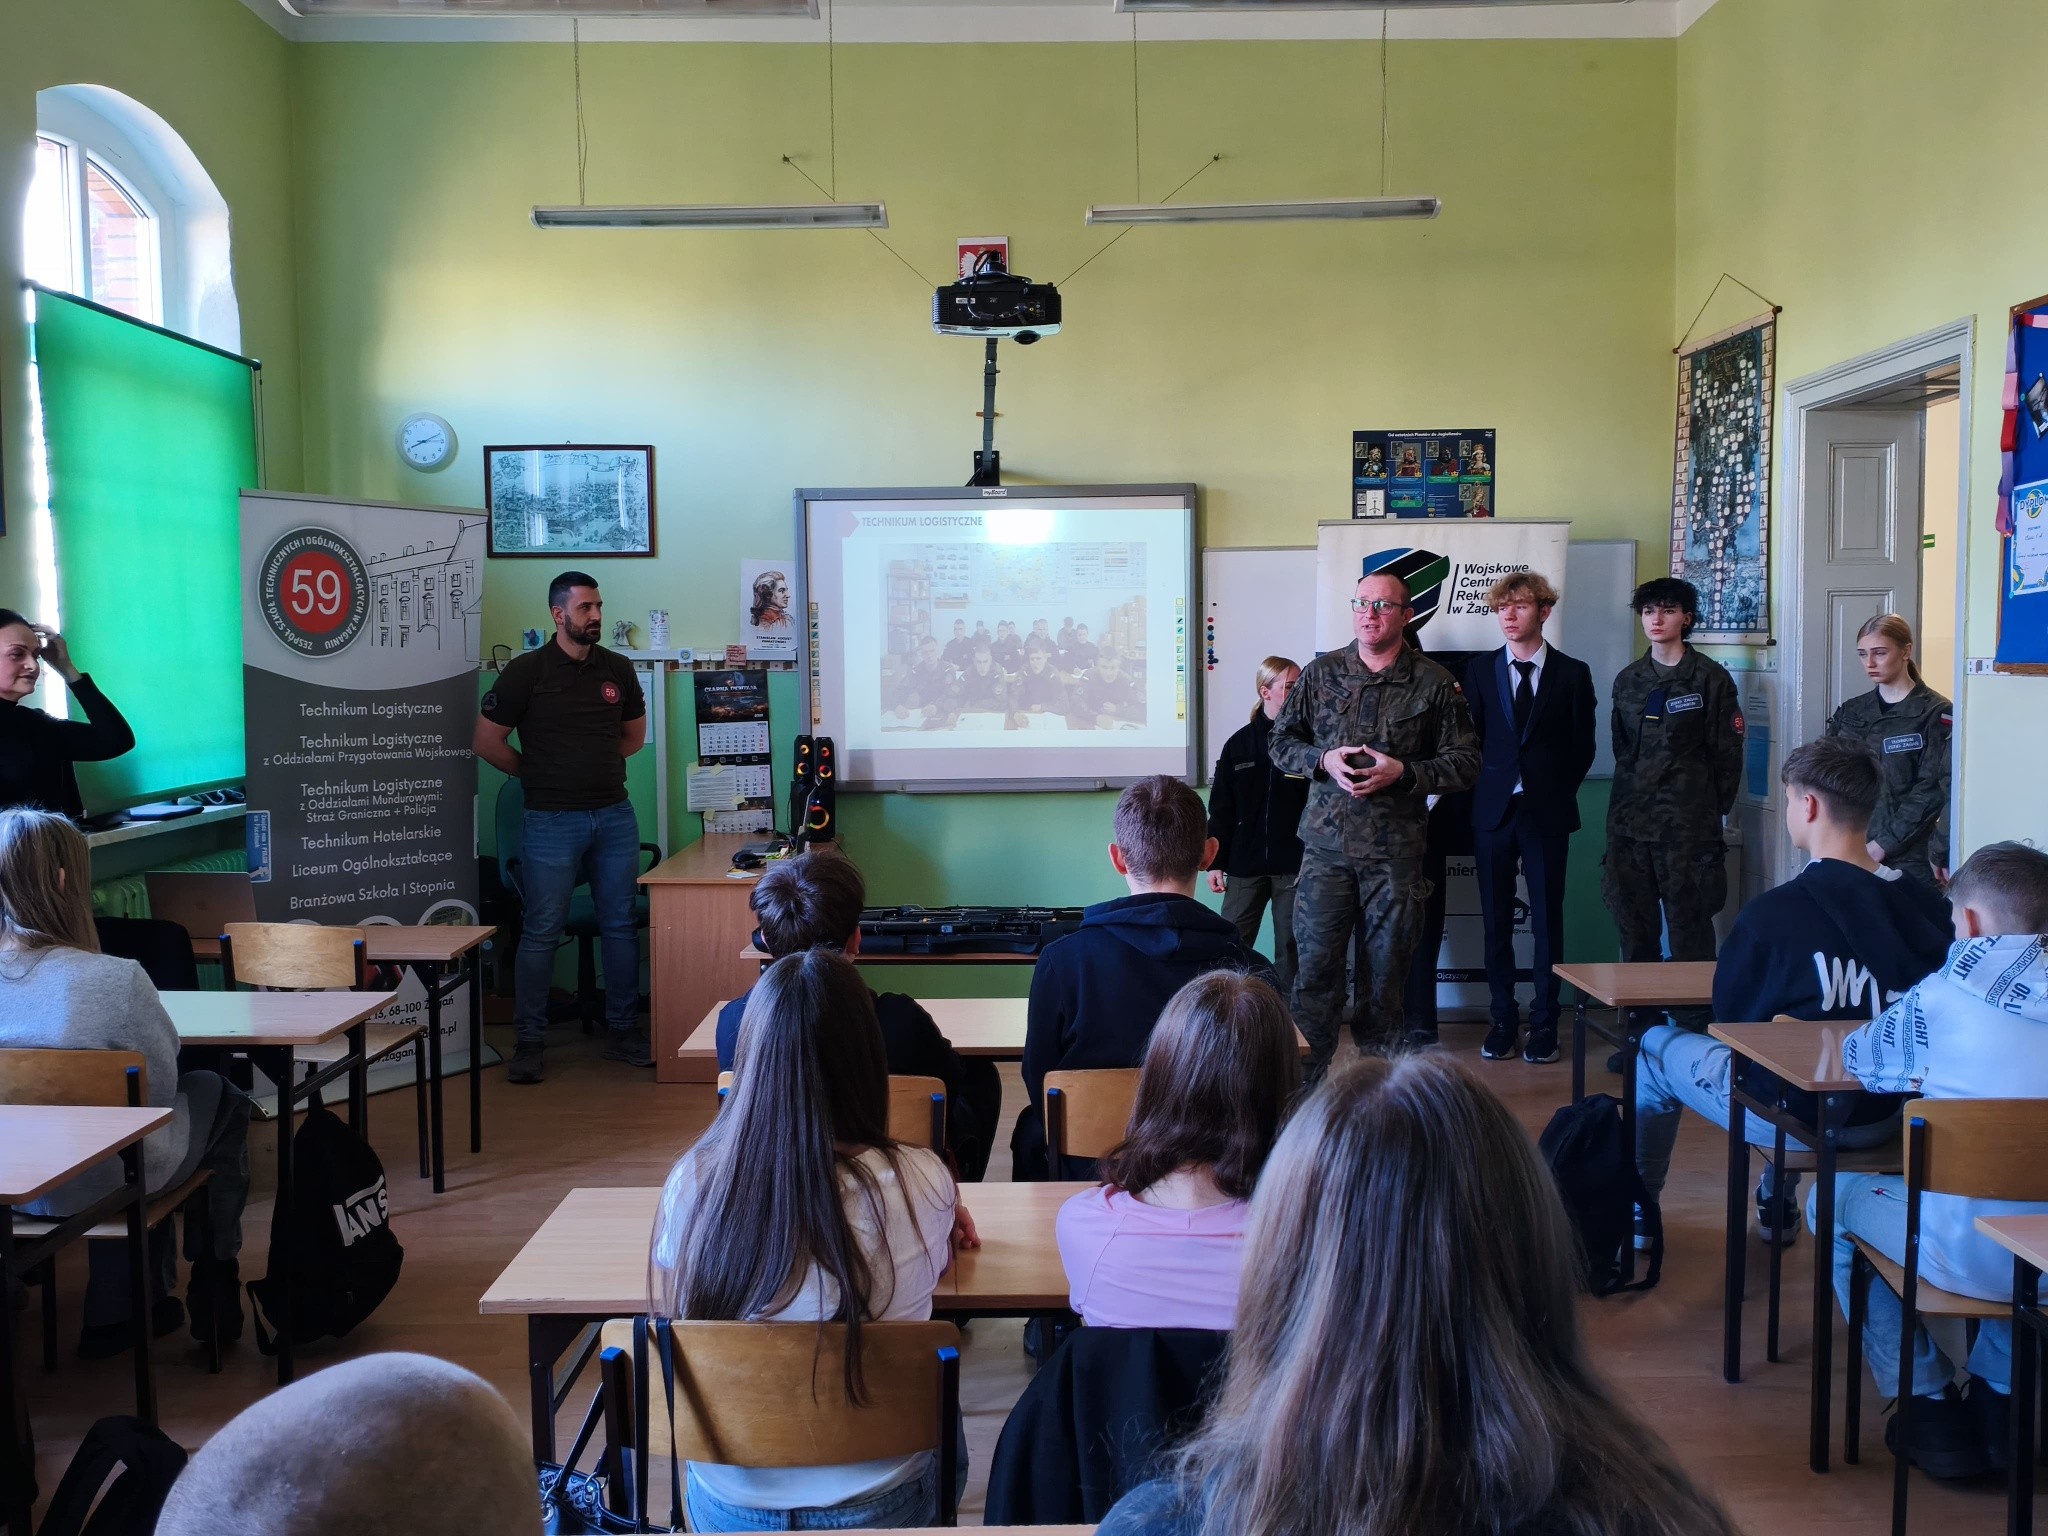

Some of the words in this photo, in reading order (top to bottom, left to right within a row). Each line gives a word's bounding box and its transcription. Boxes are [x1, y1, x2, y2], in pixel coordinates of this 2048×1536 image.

[862, 517, 917, 527] TECHNIKUM
[919, 516, 983, 526] LOGISTYCZNE
[266, 539, 301, 599] TECHNICZNYCH
[1464, 563, 1529, 577] Wojskowe
[291, 569, 342, 616] 59
[1456, 590, 1487, 601] Rekr
[267, 601, 286, 630] SZKÓŁ
[1452, 606, 1463, 614] w
[284, 628, 313, 650] ZESPÓŁ
[324, 623, 358, 650] ŻAGANIU
[605, 688, 616, 697] 59
[300, 702, 368, 718] Technikum
[372, 702, 443, 719] Logistyczne
[300, 734, 368, 749] Technikum
[372, 733, 443, 750] Logistyczne
[263, 758, 270, 766] z
[273, 750, 335, 766] Oddziałami
[338, 749, 413, 764] Przygotowania
[301, 779, 369, 797] Technikum
[372, 778, 443, 796] Logistyczne
[300, 803, 306, 811] z
[308, 796, 370, 811] Oddziałami
[372, 791, 443, 808] Mundurowymi:
[306, 811, 335, 823] Straż
[337, 807, 391, 821] Graniczna
[403, 804, 437, 819] Policja
[301, 833, 369, 850] Technikum
[373, 826, 442, 843] Hotelarskie
[292, 864, 338, 877] Liceum
[342, 850, 453, 875] Ogólnokształcące
[1446, 863, 1478, 877] nier
[290, 892, 356, 910] Branżowa
[358, 884, 400, 902] Szkoła
[409, 879, 456, 899] Stopnia
[1437, 972, 1469, 983] Ojczyzny
[389, 1002, 422, 1017] 68-100
